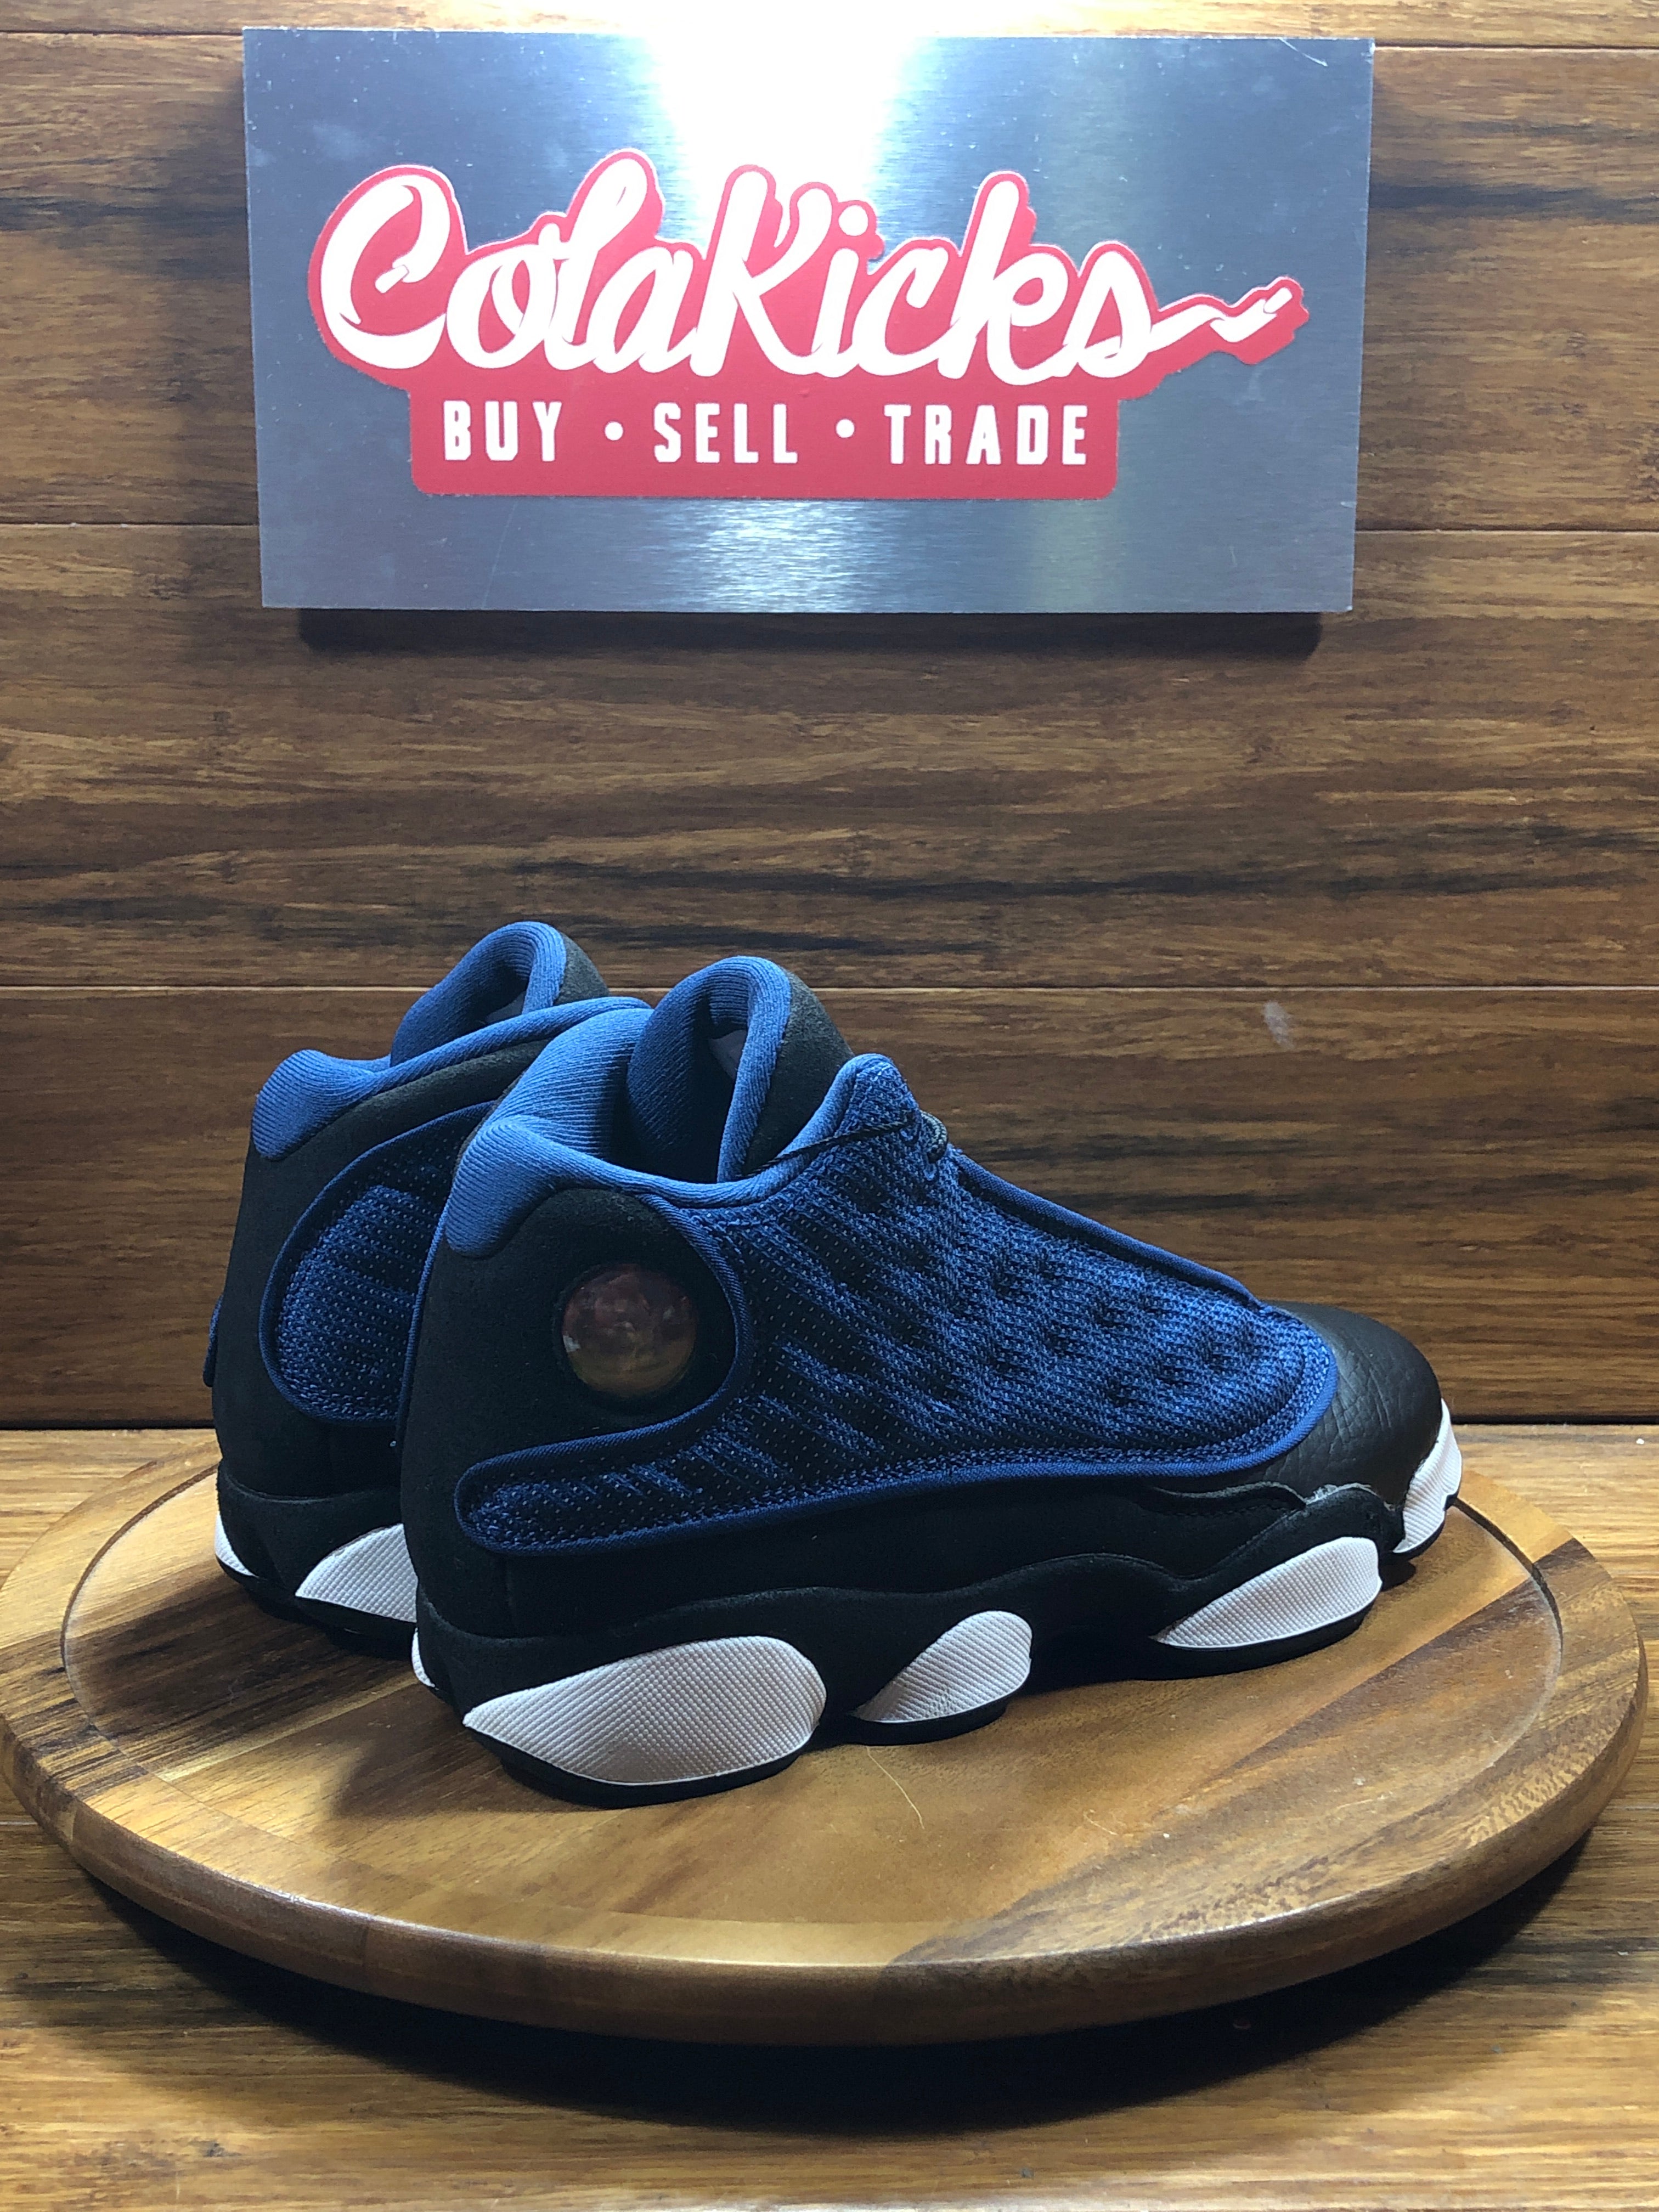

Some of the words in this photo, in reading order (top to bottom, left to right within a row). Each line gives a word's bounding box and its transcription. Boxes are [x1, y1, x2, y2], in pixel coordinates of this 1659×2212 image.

[320, 152, 1293, 385] ColaKicks
[443, 400, 562, 461] BUY
[654, 402, 798, 464] SELL
[884, 404, 1088, 465] TRADE
